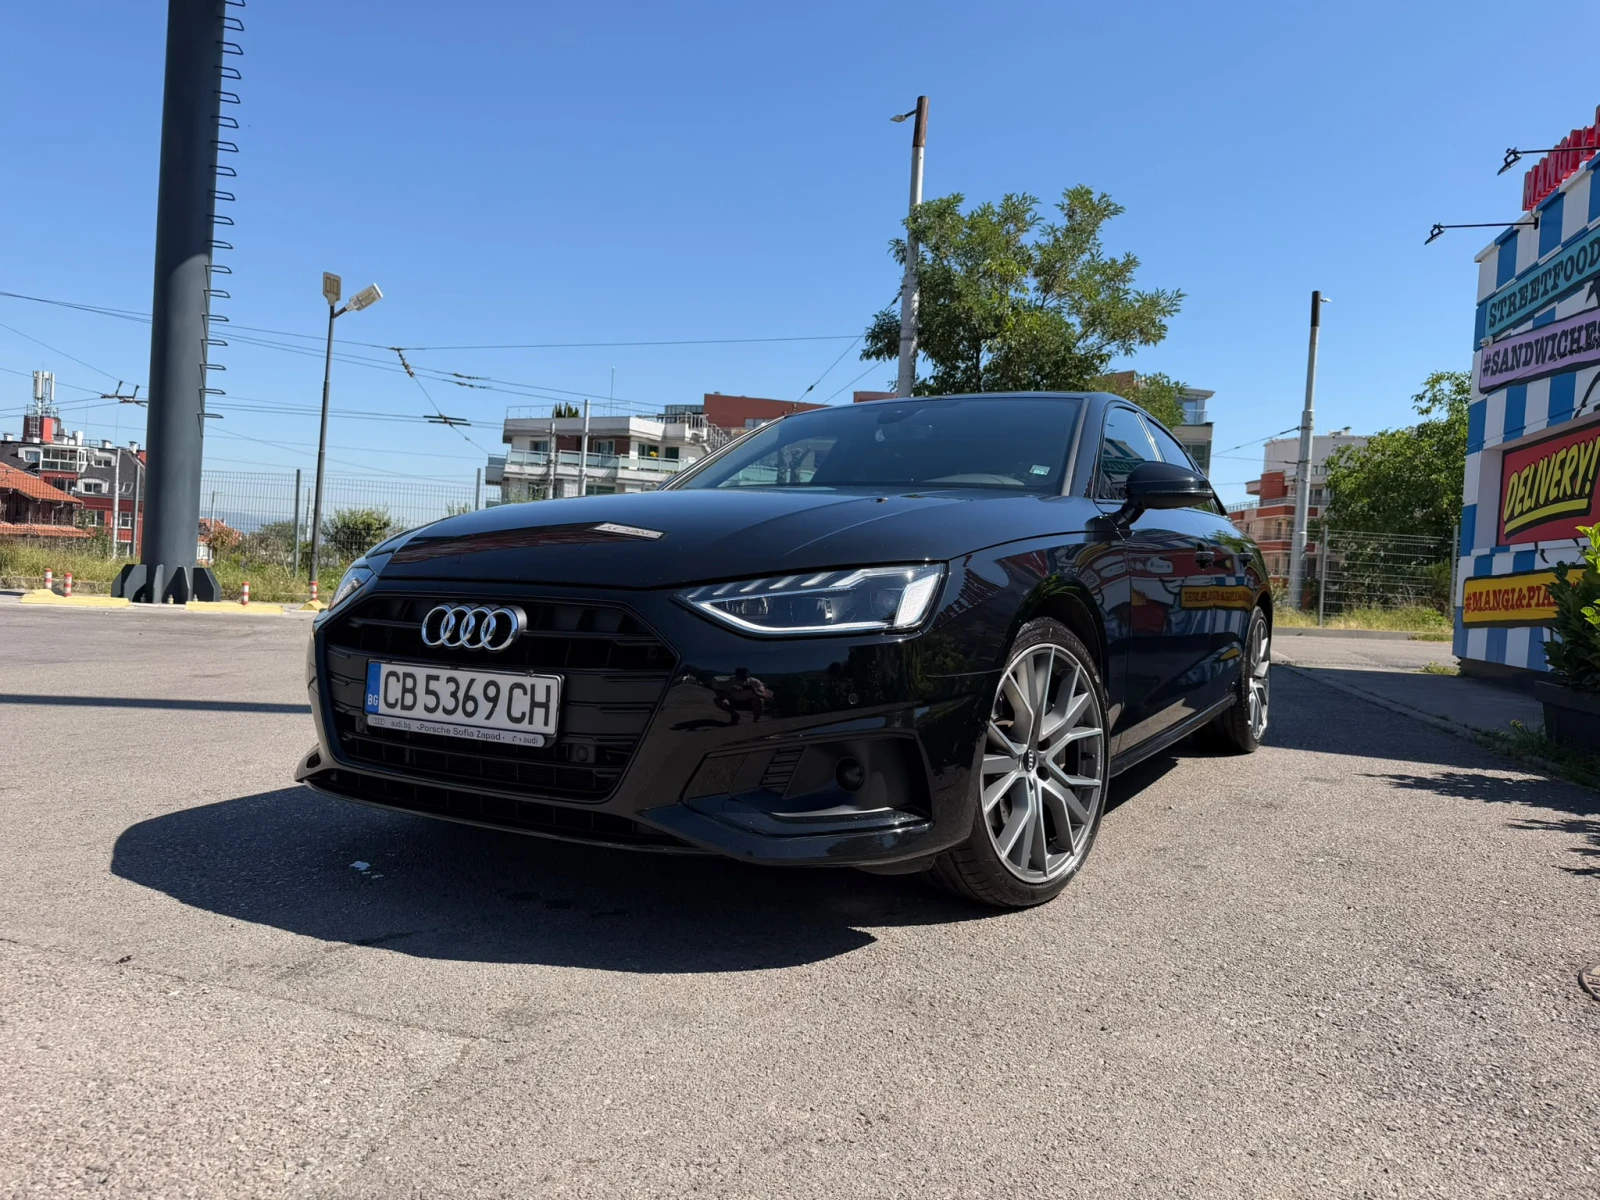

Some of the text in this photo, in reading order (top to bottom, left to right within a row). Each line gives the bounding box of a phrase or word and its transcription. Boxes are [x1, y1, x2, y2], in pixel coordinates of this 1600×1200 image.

[1488, 236, 1600, 329] STREETFOOD
[1503, 435, 1600, 522] DELIVERY!
[1464, 584, 1557, 614] #MANGI&PIA
[367, 693, 379, 706] BG
[420, 723, 451, 735] Porsche
[453, 727, 474, 738] Sofia
[476, 730, 501, 741] Zapad
